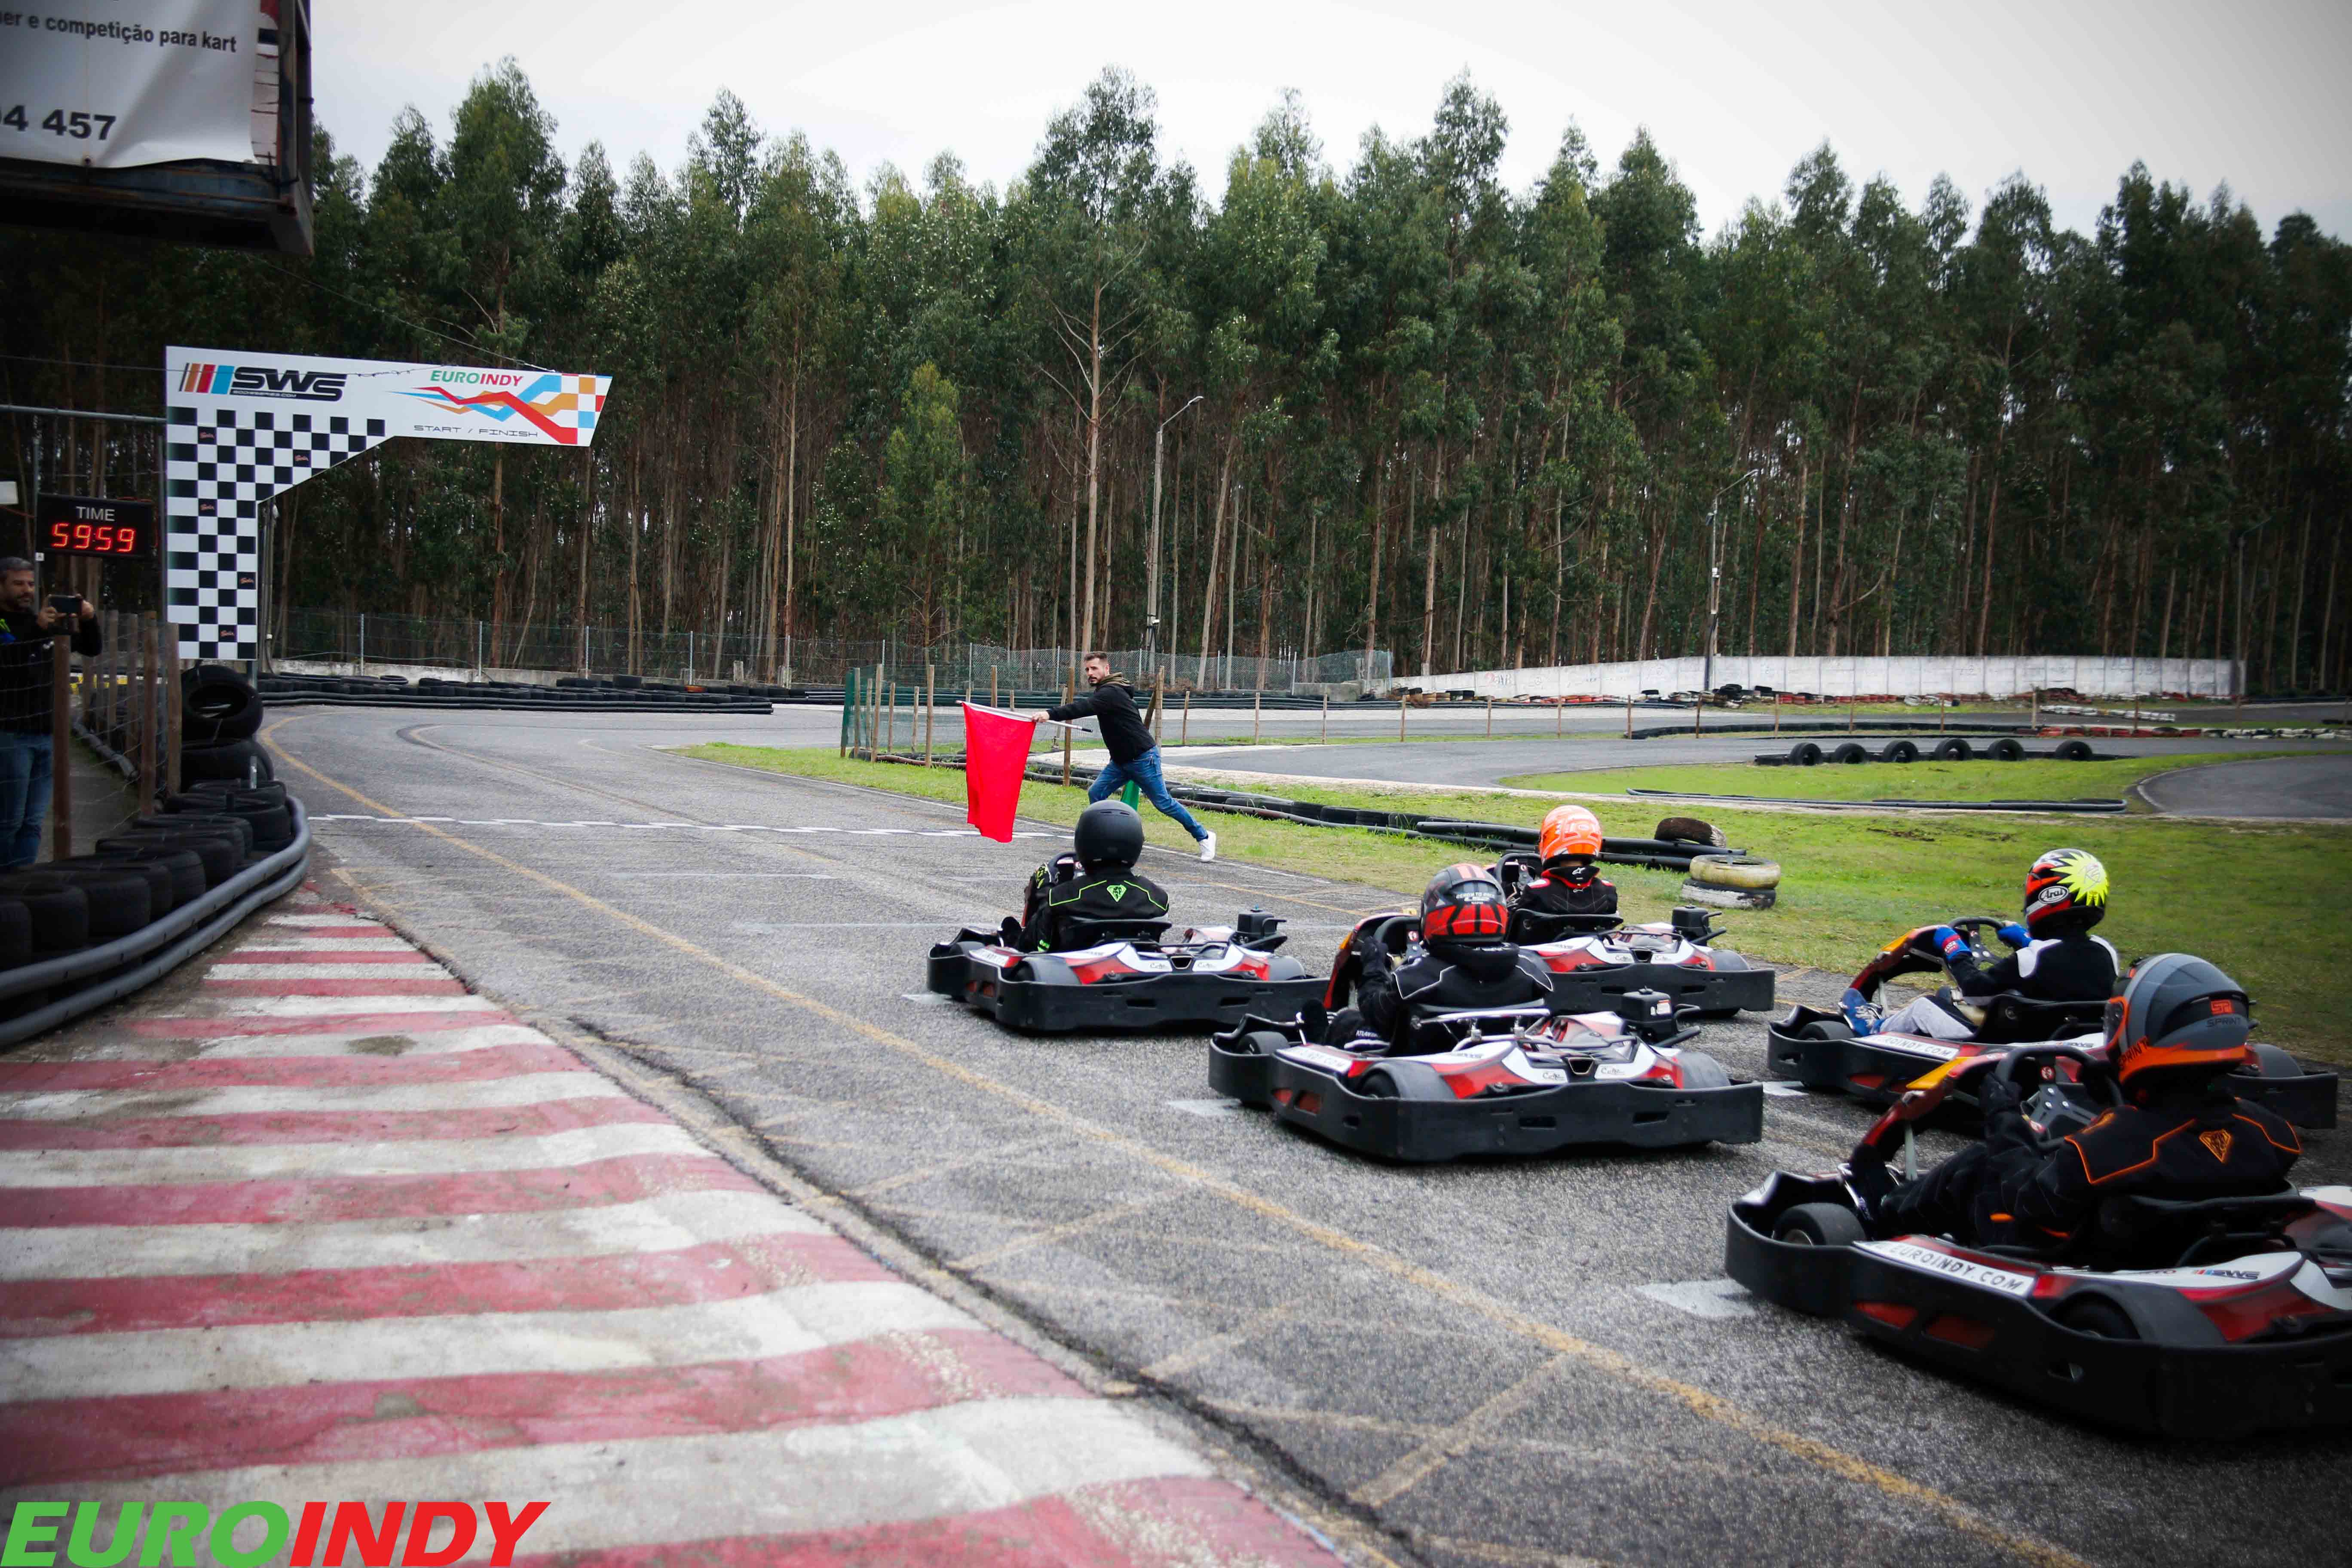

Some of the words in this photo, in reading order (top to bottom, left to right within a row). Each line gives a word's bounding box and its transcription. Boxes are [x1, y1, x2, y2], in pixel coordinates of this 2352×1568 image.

[0, 11, 22, 26] er
[28, 15, 39, 29] e
[46, 17, 153, 44] competição
[159, 31, 196, 46] para
[202, 31, 236, 52] kart
[0, 104, 29, 131] 4
[42, 109, 116, 141] 457
[231, 367, 347, 401] SWS
[430, 370, 523, 386] EUROINDY
[414, 425, 461, 433] START
[479, 429, 537, 437] FINISH
[76, 506, 115, 521] TIME
[2042, 887, 2064, 899] Arai
[2208, 1017, 2241, 1028] SPRINT
[2119, 1035, 2149, 1069] SPRINT
[2212, 1270, 2260, 1280] SWS
